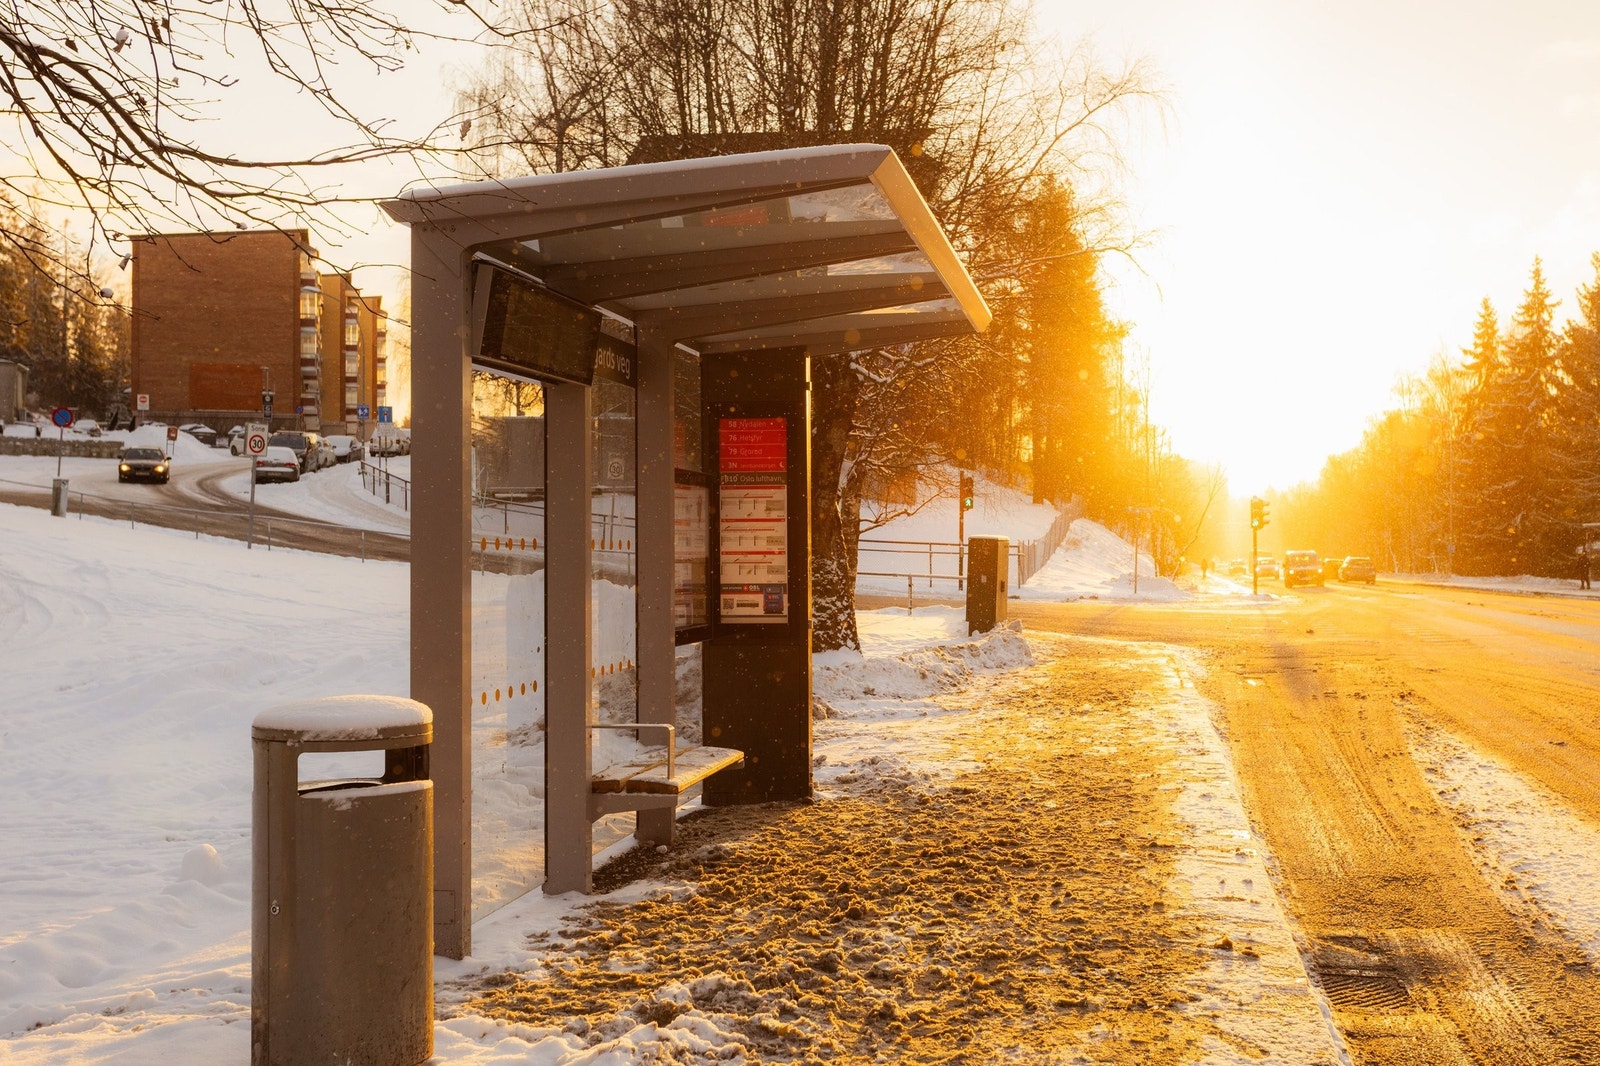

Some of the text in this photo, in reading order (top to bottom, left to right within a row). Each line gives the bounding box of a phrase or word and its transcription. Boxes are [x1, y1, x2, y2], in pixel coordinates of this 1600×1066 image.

[616, 354, 631, 380] veg
[251, 424, 265, 432] Sone
[728, 434, 738, 442] 76
[252, 439, 262, 449] 30
